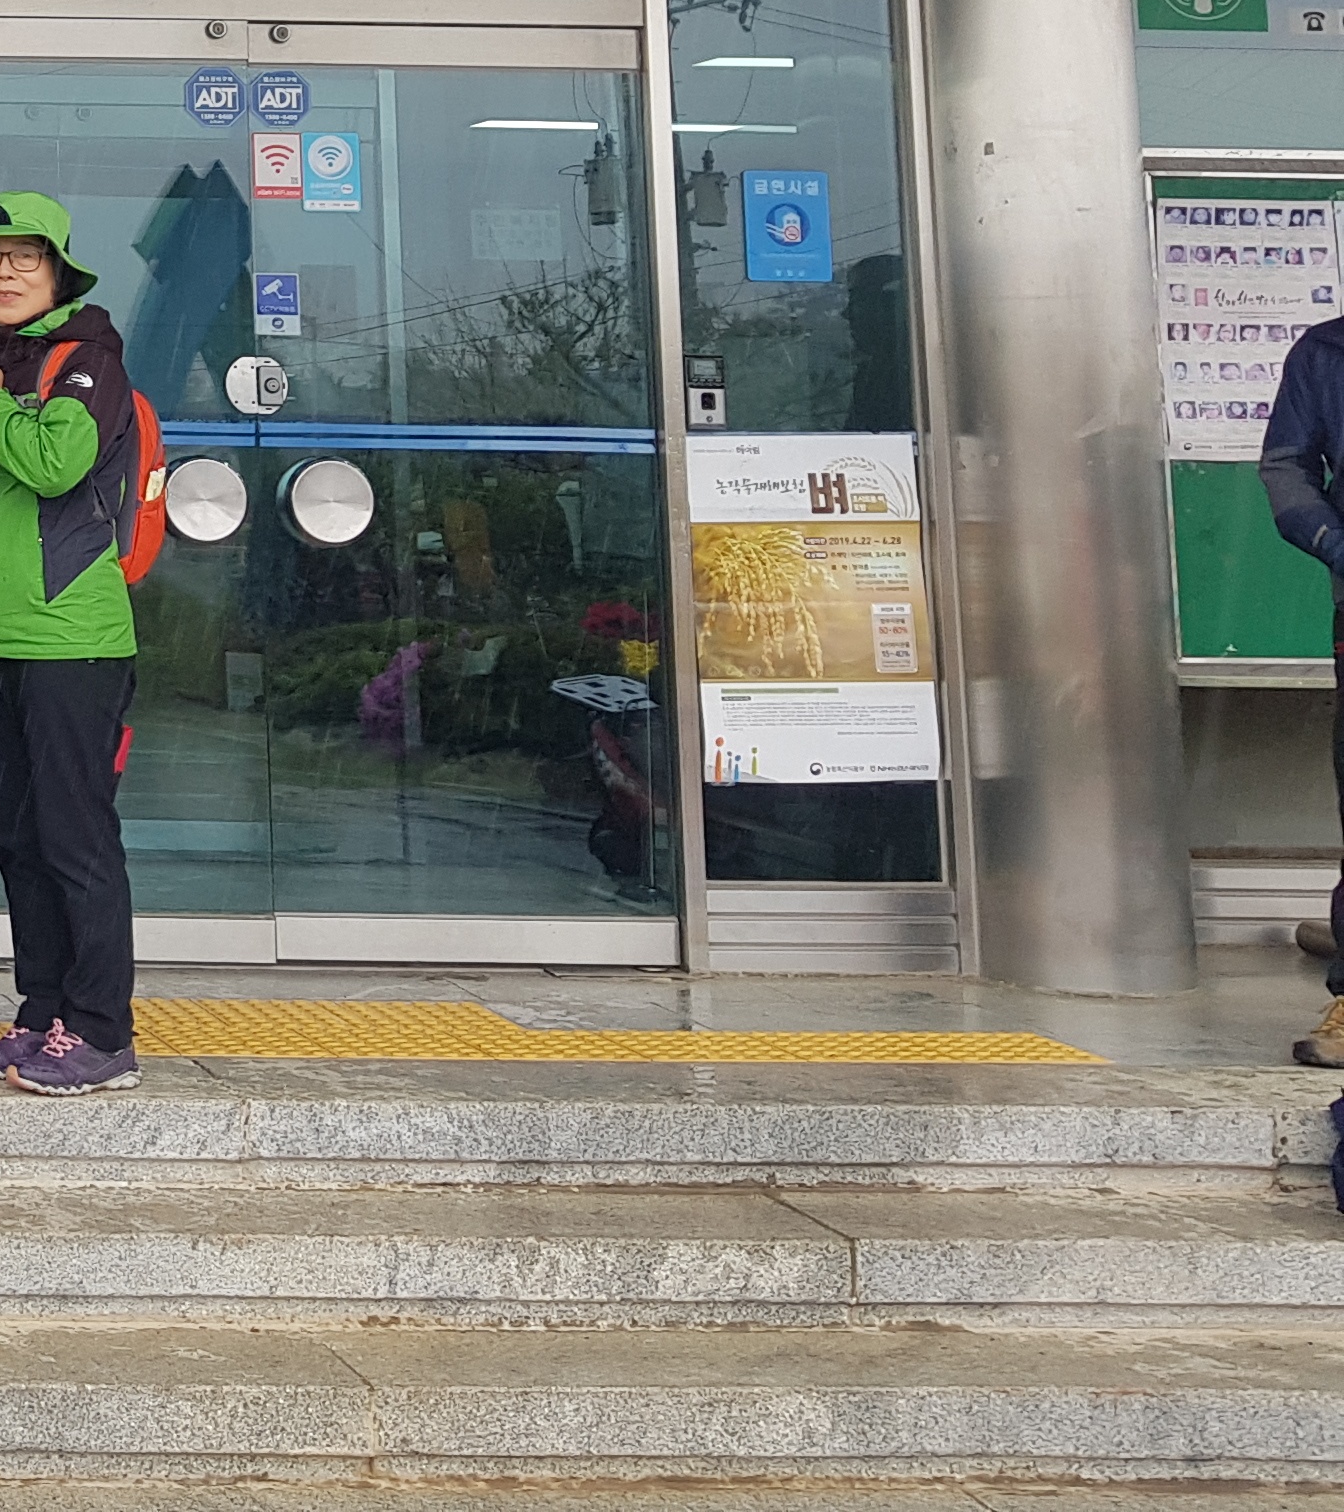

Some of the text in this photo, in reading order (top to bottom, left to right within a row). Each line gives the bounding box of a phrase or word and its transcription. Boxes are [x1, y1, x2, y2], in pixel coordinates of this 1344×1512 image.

[195, 87, 237, 108] ADT
[259, 88, 302, 109] ADT
[807, 472, 850, 514] 벼
